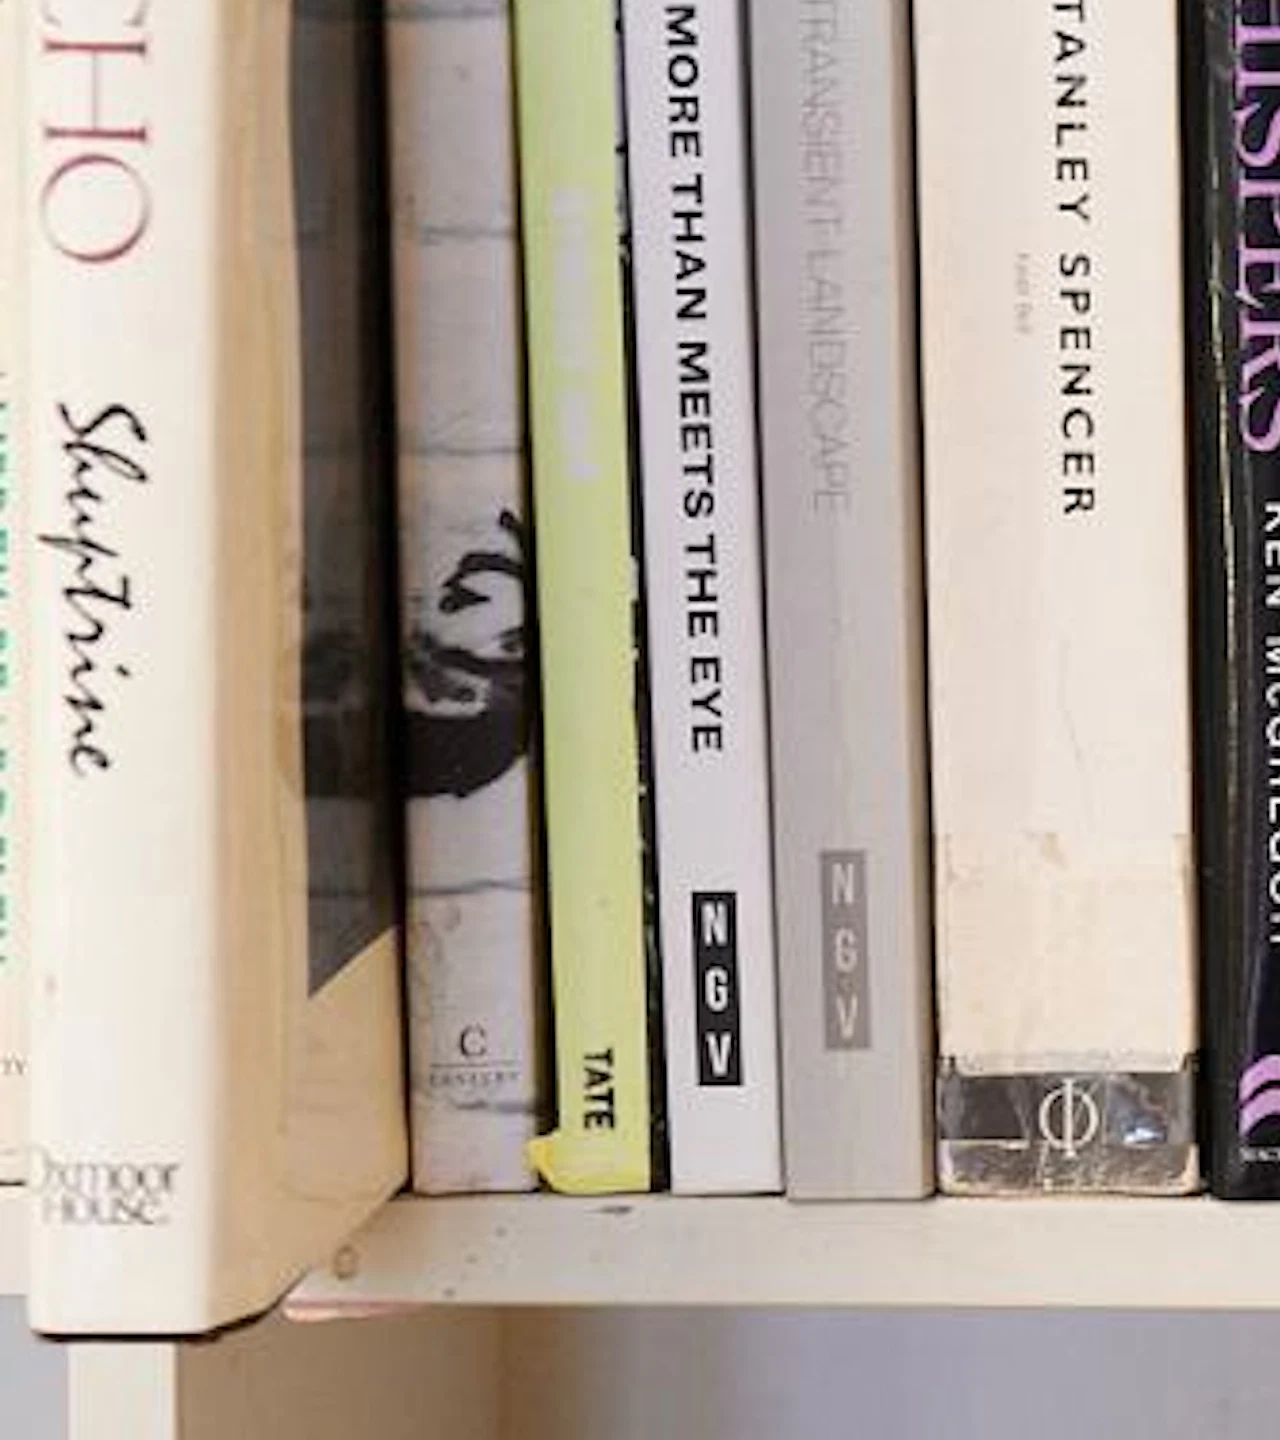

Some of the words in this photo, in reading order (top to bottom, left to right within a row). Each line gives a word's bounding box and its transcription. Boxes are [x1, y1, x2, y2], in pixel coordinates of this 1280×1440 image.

[665, 6, 701, 159] MORE
[671, 174, 706, 320] THAN
[679, 341, 715, 519] MEETS
[806, 248, 851, 515] LANDSCAPE
[1059, 253, 1096, 516] SPENCER
[38, 402, 150, 778] Shuptrine
[686, 534, 718, 637] THE
[690, 656, 722, 753] EYE
[583, 1047, 615, 1129] TATE
